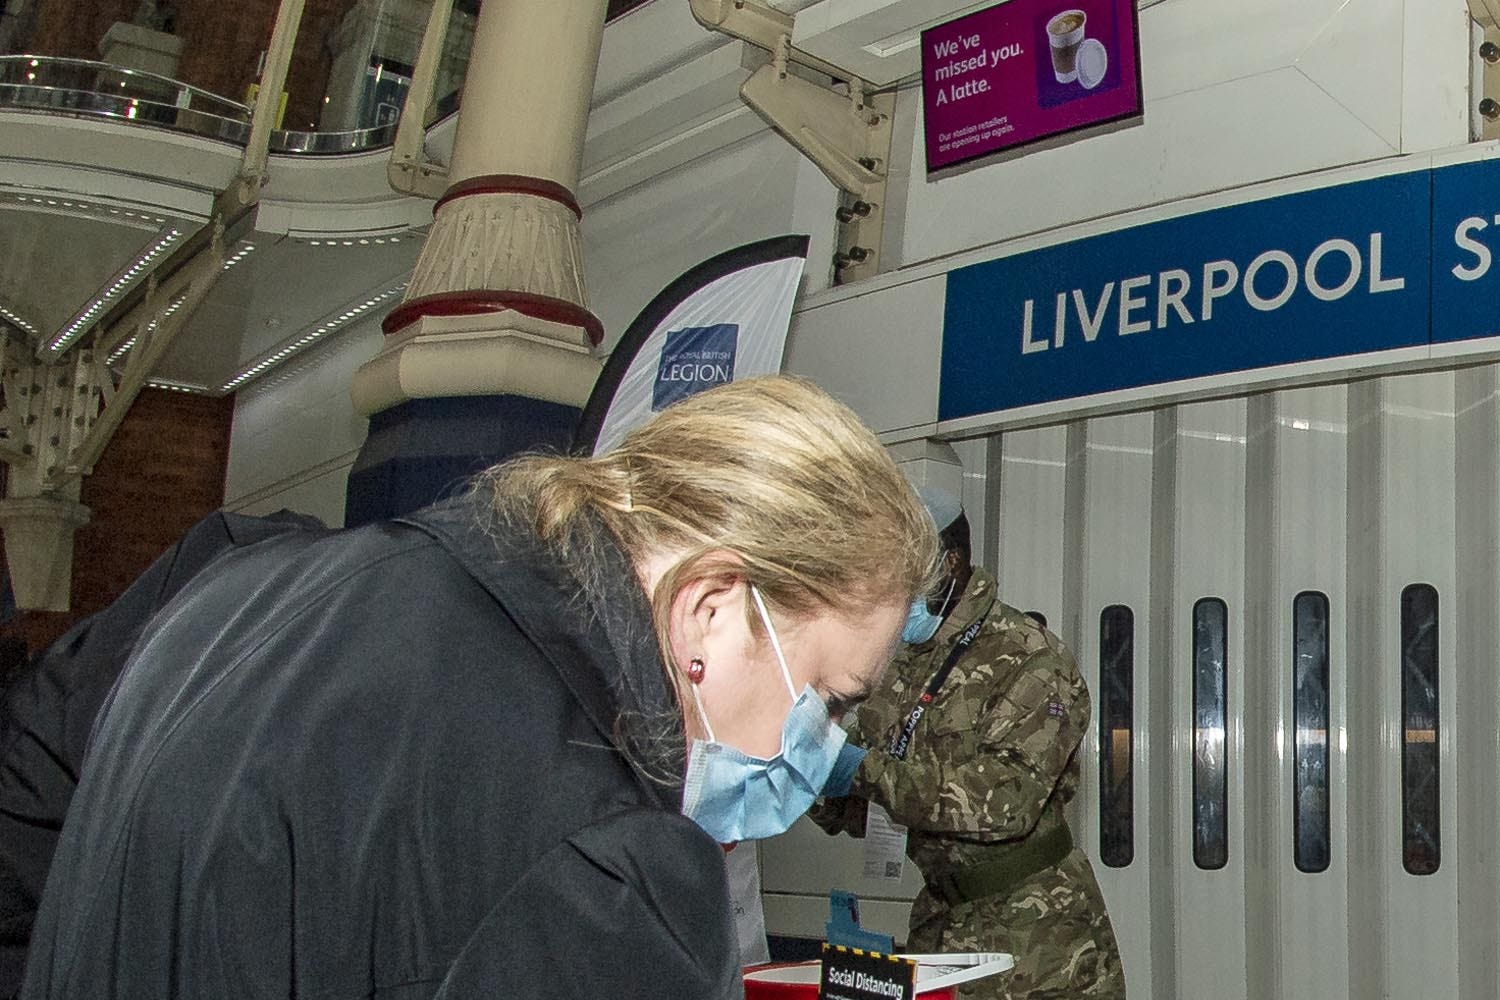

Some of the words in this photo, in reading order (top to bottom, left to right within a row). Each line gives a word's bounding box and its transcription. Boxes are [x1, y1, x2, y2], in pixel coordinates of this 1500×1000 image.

[934, 33, 981, 59] We've
[935, 50, 987, 81] missed
[991, 42, 1024, 68] you.
[936, 89, 948, 107] A
[951, 77, 992, 102] latte.
[939, 131, 952, 143] Our
[952, 123, 978, 140] station
[978, 115, 1008, 132] retailers
[1022, 232, 1406, 356] LIVERPOOL
[660, 363, 730, 383] LEGION
[905, 705, 925, 735] POPPY
[828, 966, 855, 987] Social
